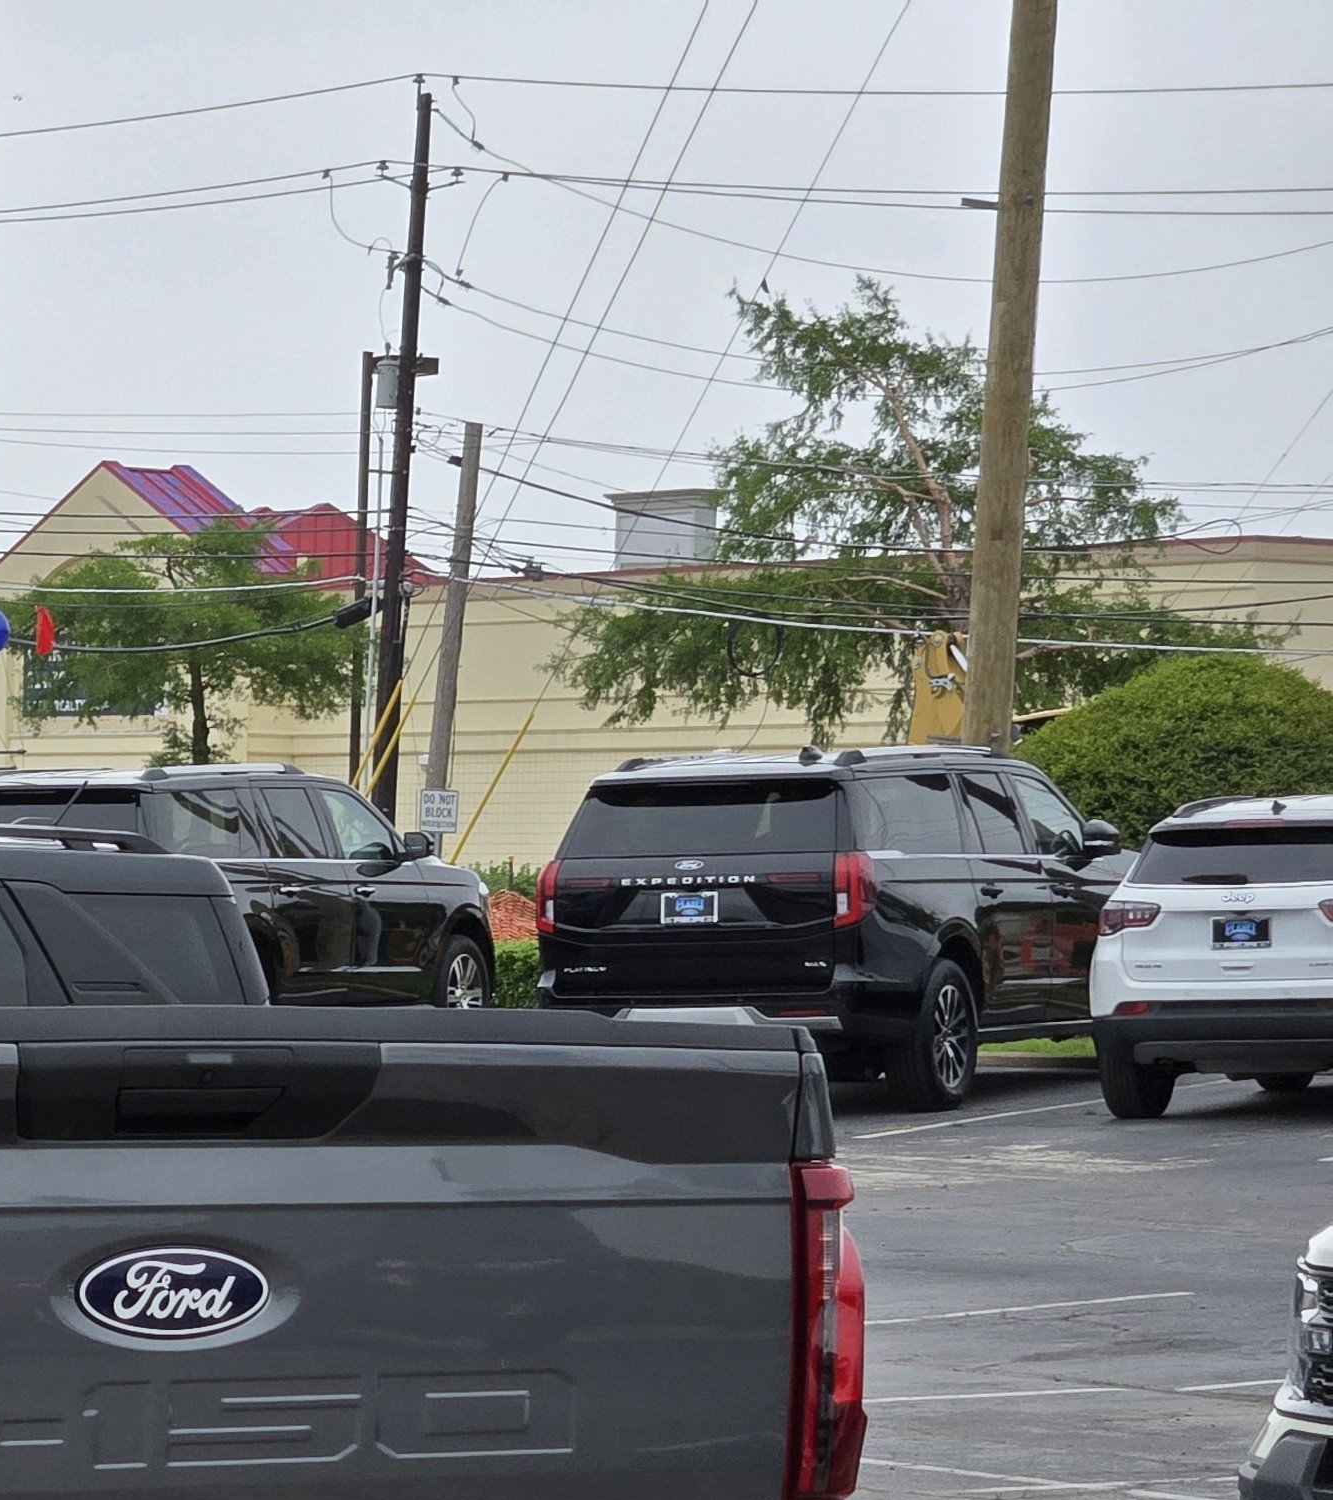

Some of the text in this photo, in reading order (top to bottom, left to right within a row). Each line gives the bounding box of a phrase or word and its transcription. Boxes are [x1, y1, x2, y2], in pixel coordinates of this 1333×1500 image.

[424, 793, 456, 805] DO NOT
[425, 806, 453, 818] BLOCK
[620, 874, 756, 888] EXPEDITION
[1222, 891, 1256, 904] Jeep
[114, 1259, 235, 1321] Ford
